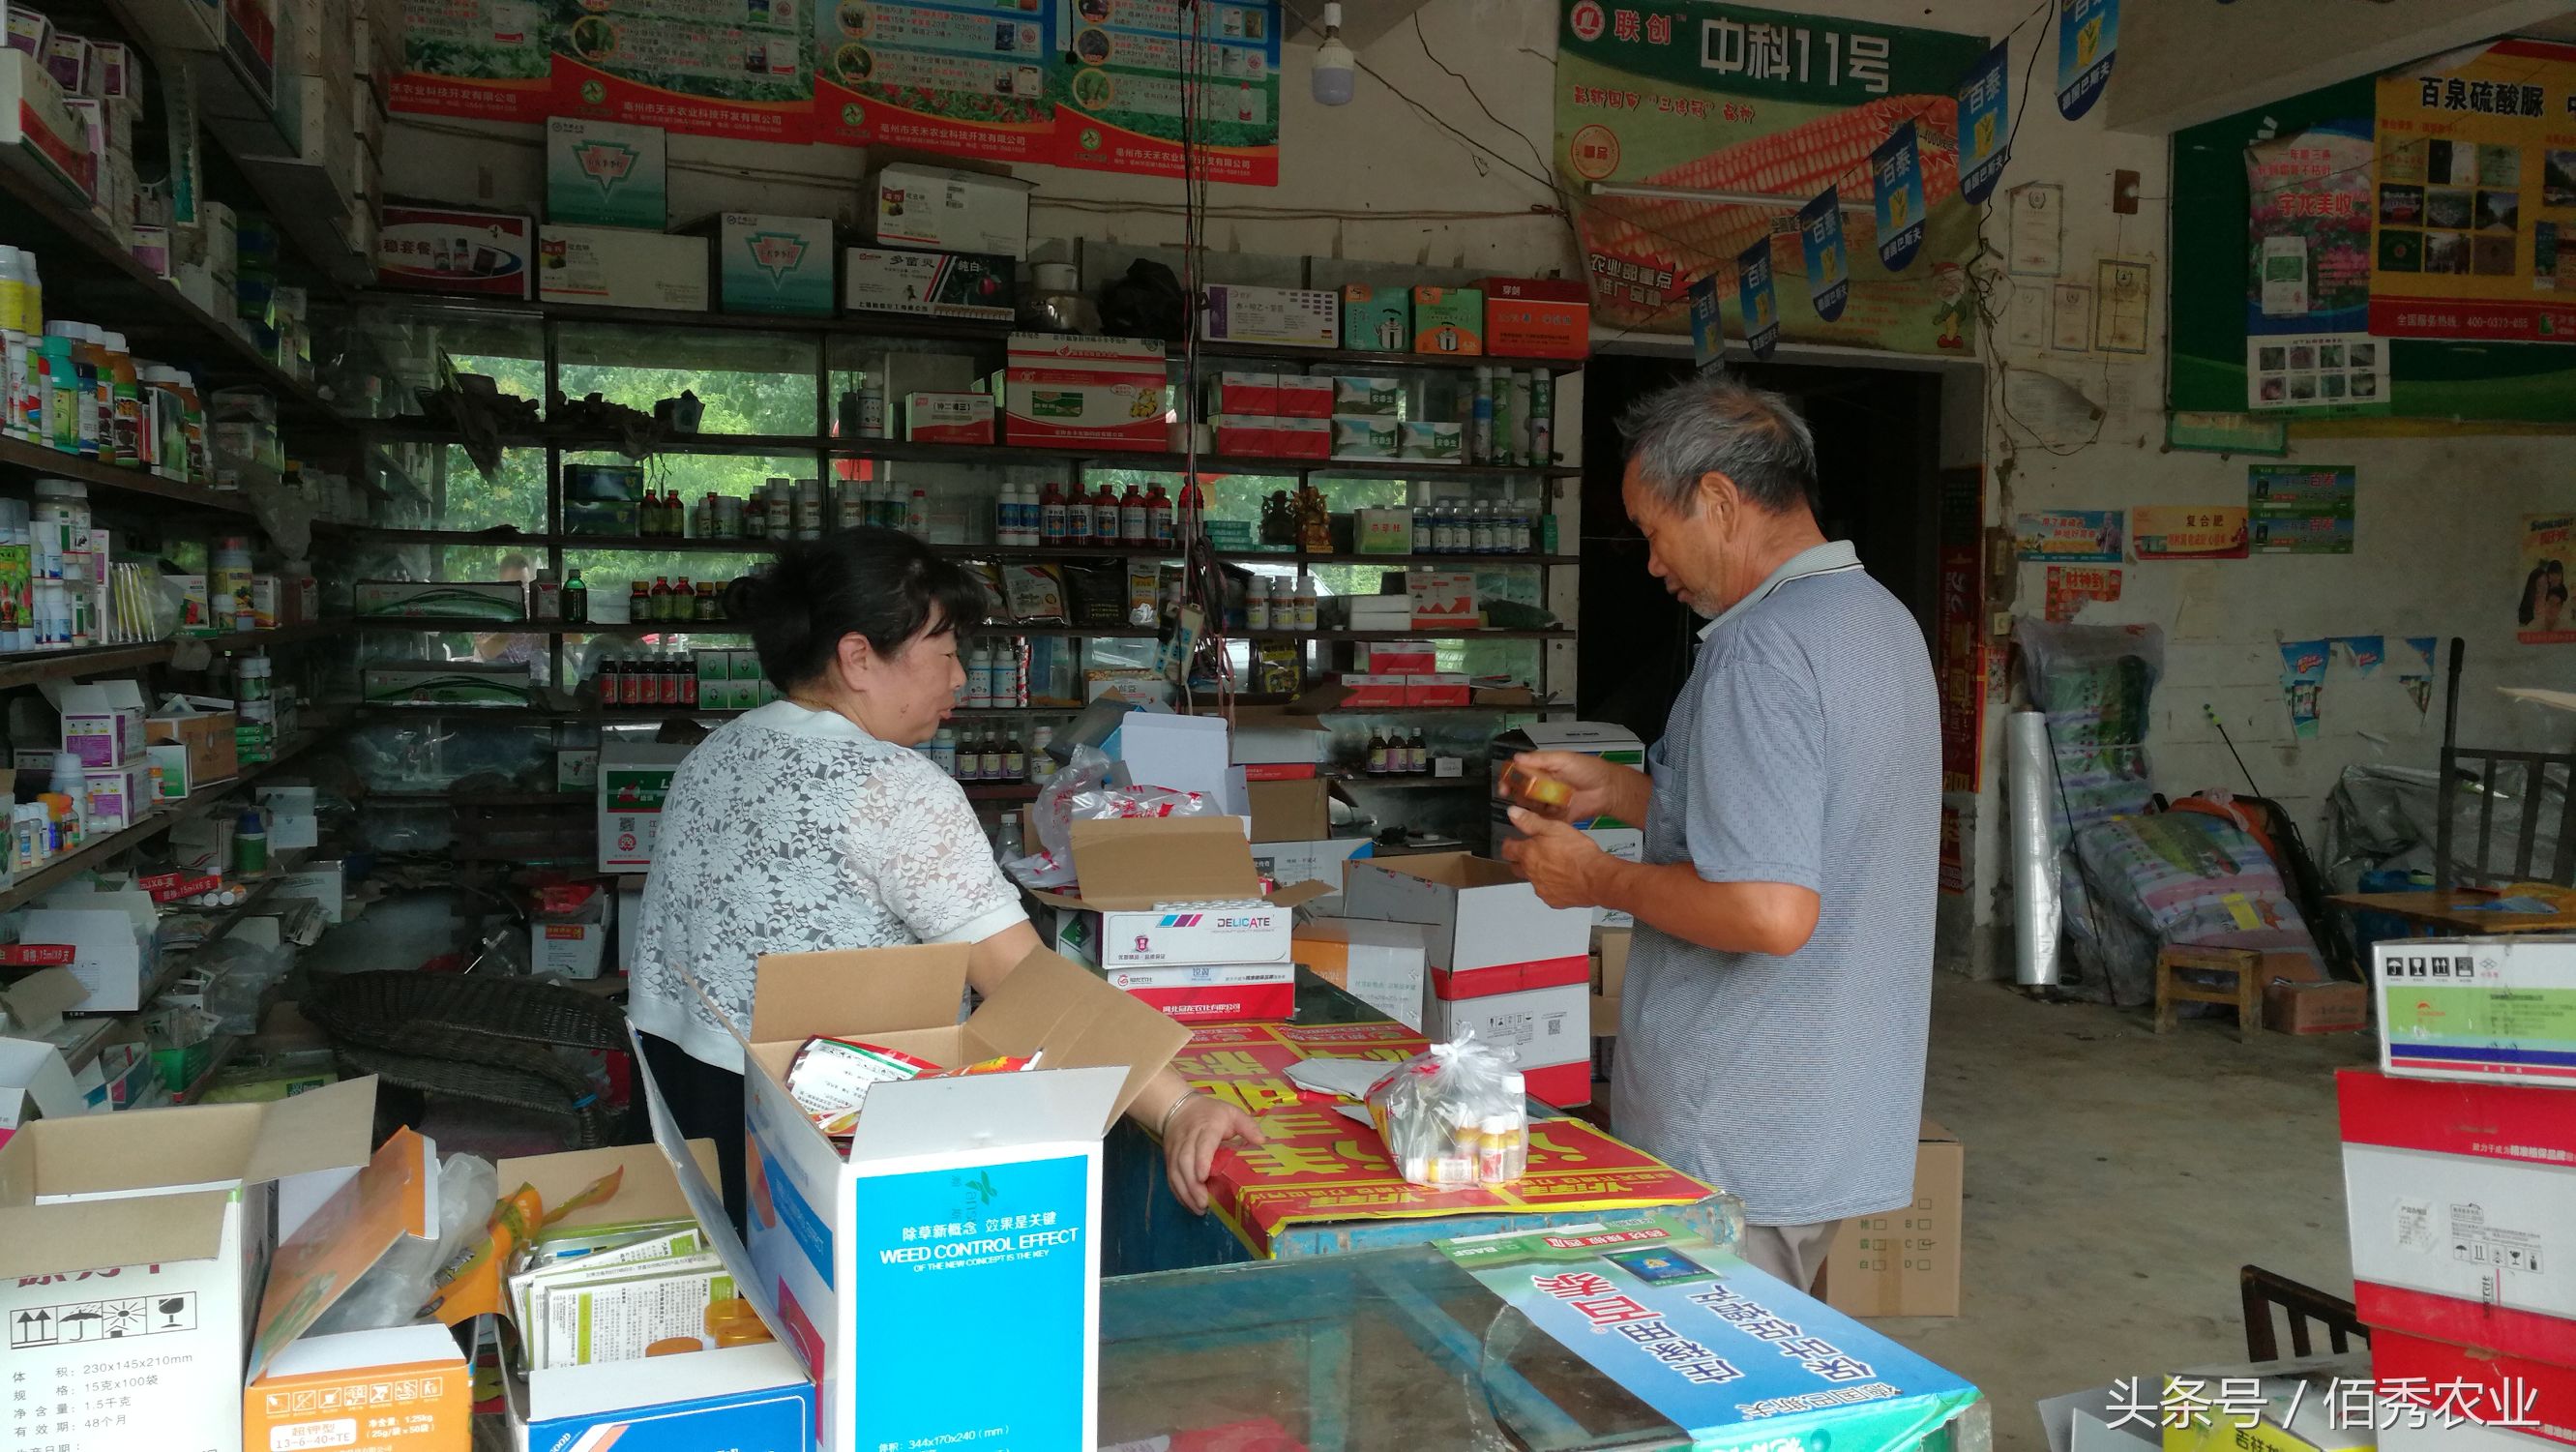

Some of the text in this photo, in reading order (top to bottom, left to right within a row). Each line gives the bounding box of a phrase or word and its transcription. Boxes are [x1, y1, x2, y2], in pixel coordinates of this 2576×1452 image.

[1614, 9, 1672, 45] 联创
[1701, 16, 1890, 94] 中科11号
[1969, 66, 2002, 114] 百泰
[2061, 61, 2112, 111] 德国巴斯夫
[2419, 76, 2544, 117] 百泉硫酸脲
[1882, 145, 1912, 188] 百泰
[1964, 155, 2004, 194] 德国巴斯夫
[380, 238, 431, 256] 稳套餐
[1882, 226, 1923, 261] 德国巴斯夫
[1590, 252, 1673, 290] 农业部重点
[2186, 515, 2224, 527] 复合肥
[1217, 917, 1270, 929] DELICATE
[902, 1210, 1058, 1242] 除草新概念 效果是关键
[879, 1227, 1080, 1265] WEED CONTROL EFFECT
[913, 1248, 1050, 1273] OF THE NEW CONCEPT IS THE KEY
[1452, 1245, 1498, 1258] BASF
[84, 1396, 132, 1410] 1.5千克
[1735, 1381, 1904, 1420] 德国巴斯夫
[84, 1414, 127, 1429] 48个月
[276, 1433, 351, 1450] 13-6-40+TE
